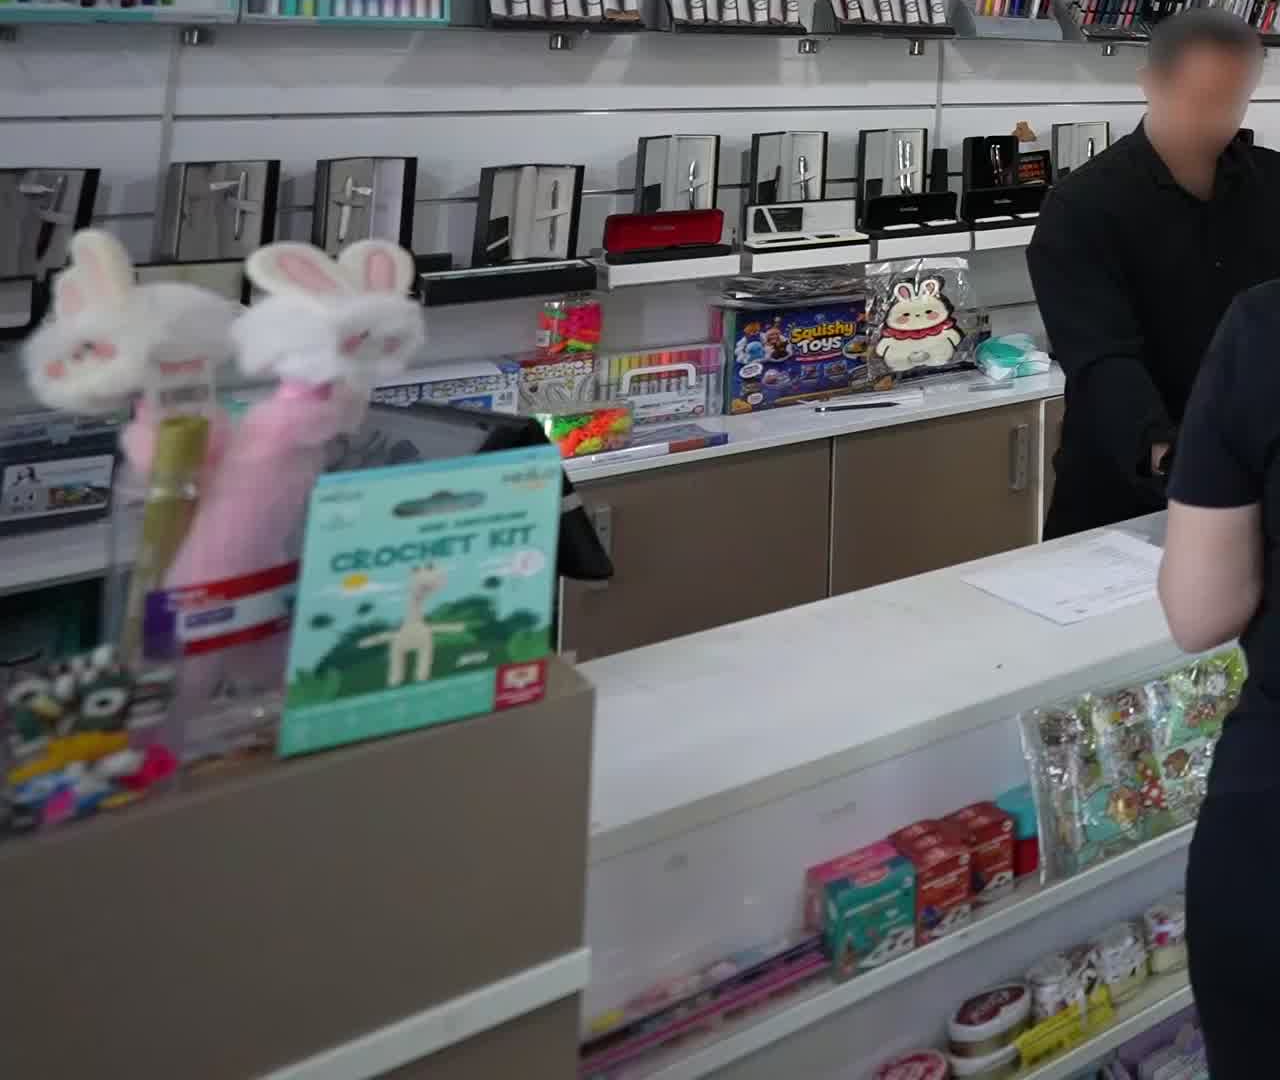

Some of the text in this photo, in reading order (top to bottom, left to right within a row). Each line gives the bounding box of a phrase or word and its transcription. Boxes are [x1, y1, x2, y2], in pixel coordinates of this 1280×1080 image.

[789, 321, 857, 343] Squishy
[330, 532, 480, 573] CROCHET
[488, 523, 537, 549] KIT
